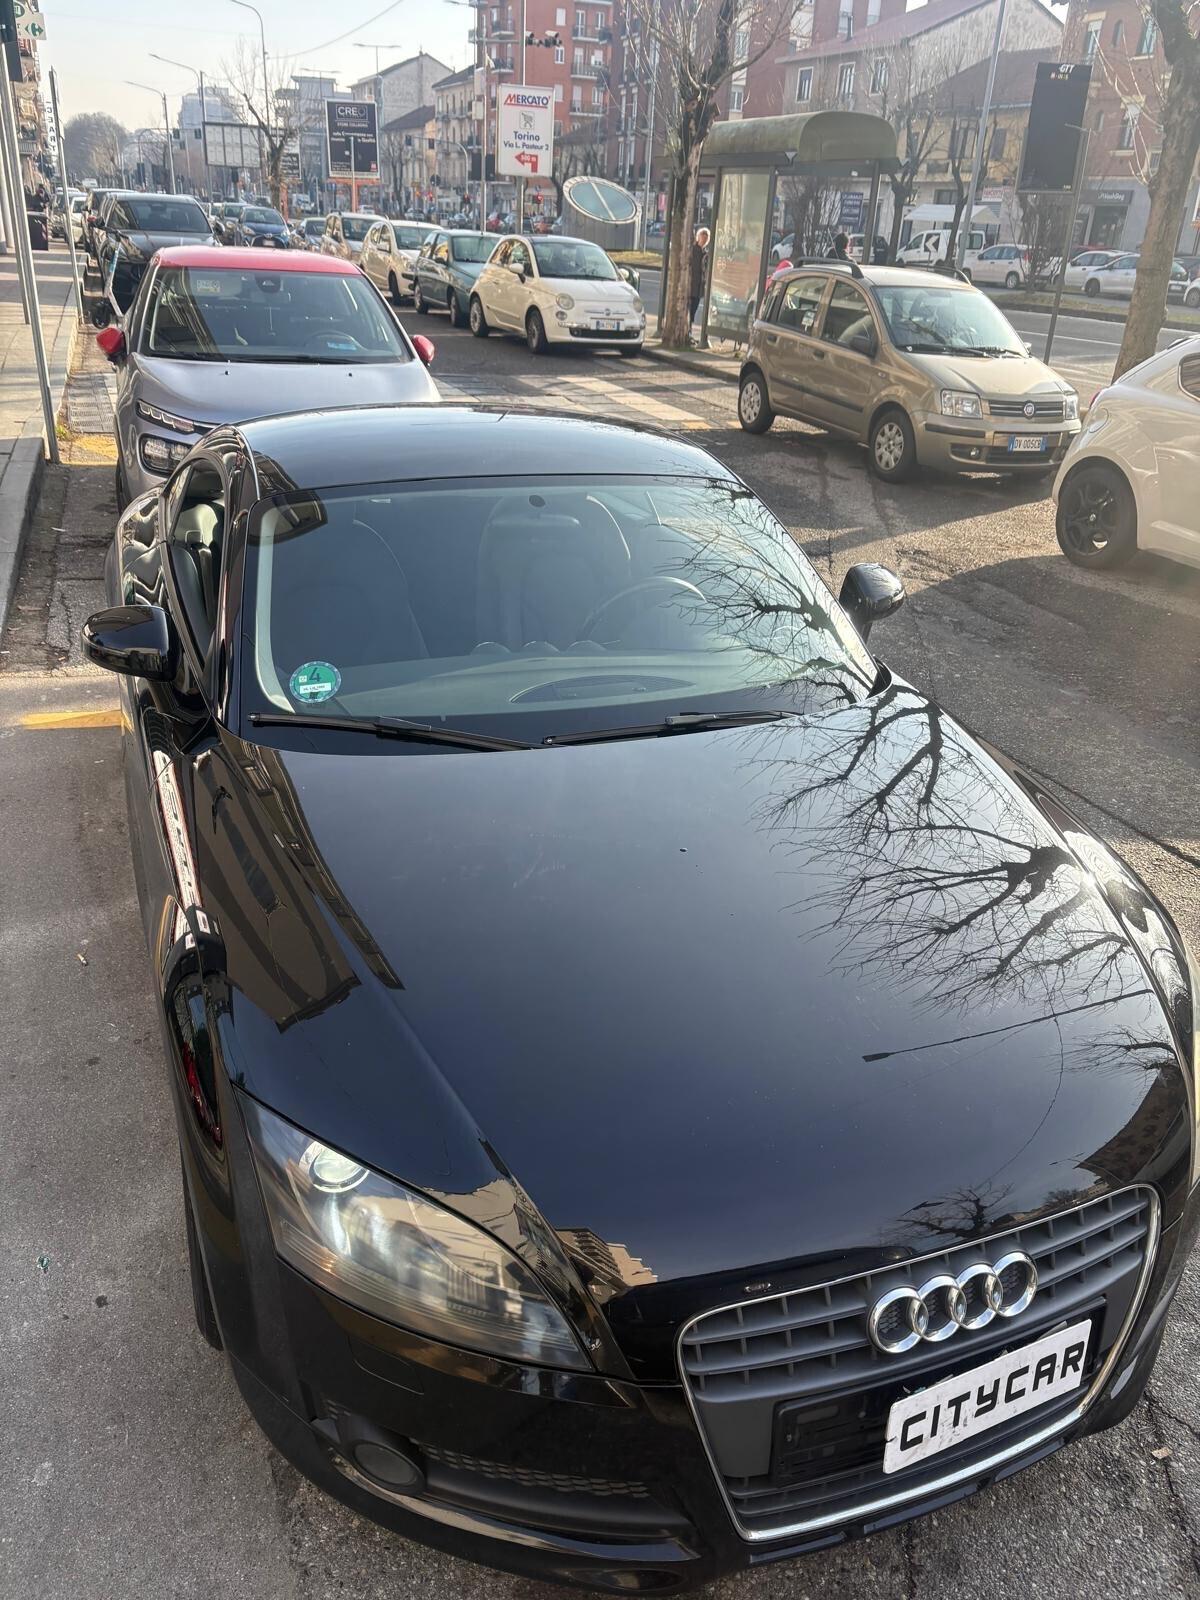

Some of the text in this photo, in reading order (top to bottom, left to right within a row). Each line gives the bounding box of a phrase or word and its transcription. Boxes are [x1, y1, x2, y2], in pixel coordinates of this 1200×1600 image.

[338, 106, 366, 116] CREO
[513, 130, 540, 142] Torino
[522, 142, 544, 150] Pasteur
[309, 667, 321, 682] 4
[900, 1340, 1085, 1451] CITYCAR
